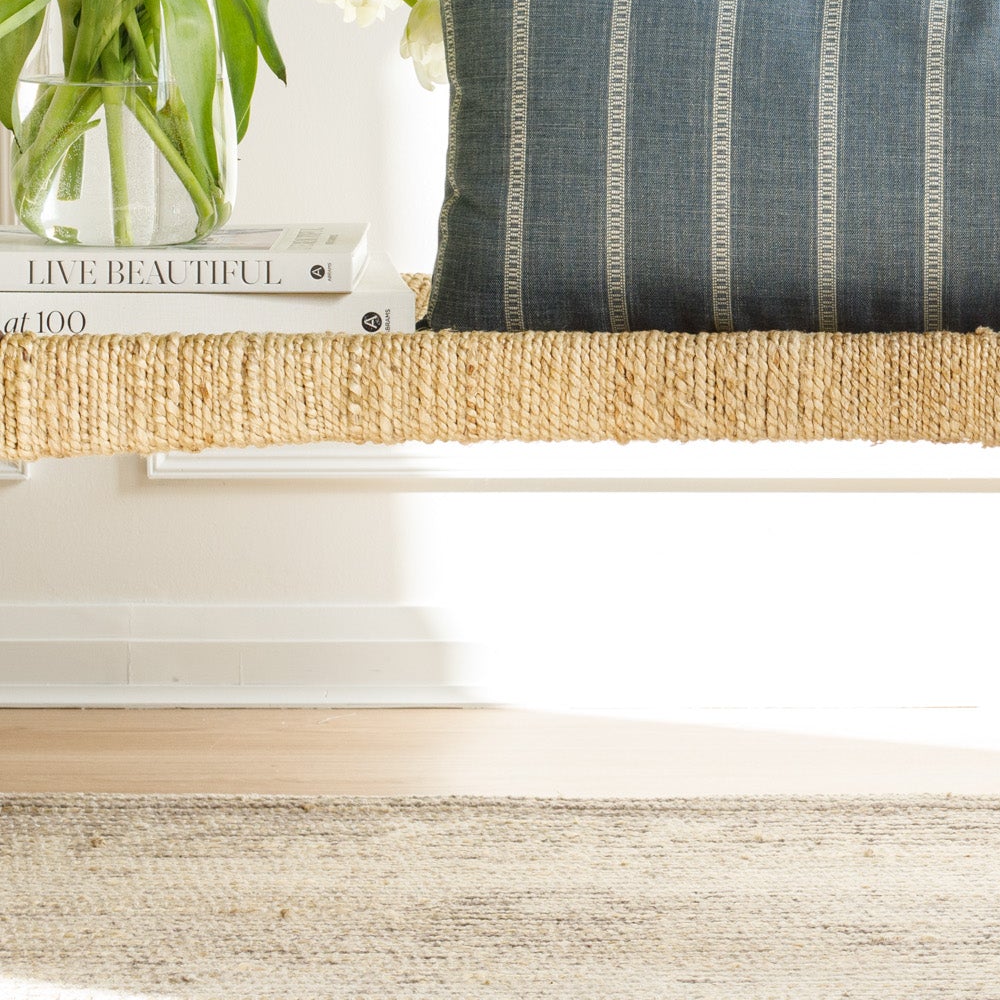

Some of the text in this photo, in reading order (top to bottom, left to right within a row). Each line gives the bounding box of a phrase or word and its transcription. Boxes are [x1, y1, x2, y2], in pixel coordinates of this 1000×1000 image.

[27, 260, 282, 285] LIVE BEAUTIFUL
[311, 266, 324, 279] A
[3, 310, 86, 334] at 100
[363, 314, 378, 330] A
